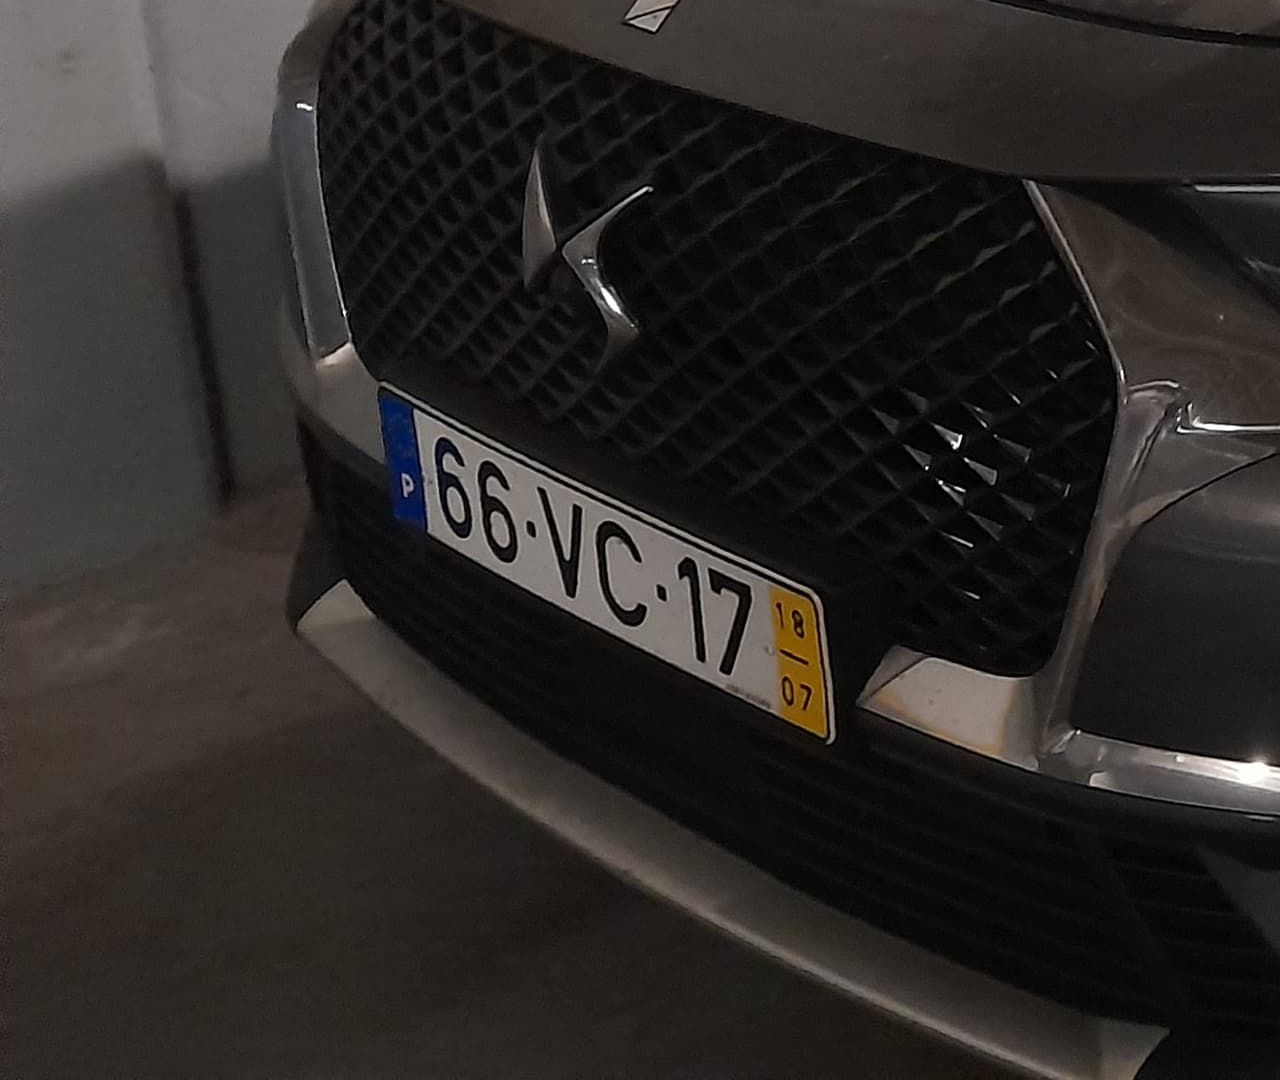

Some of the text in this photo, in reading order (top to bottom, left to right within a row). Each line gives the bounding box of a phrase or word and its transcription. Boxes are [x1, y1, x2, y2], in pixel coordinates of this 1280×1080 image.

[400, 471, 416, 499] P
[775, 601, 806, 640] 18
[781, 675, 813, 712] 07
